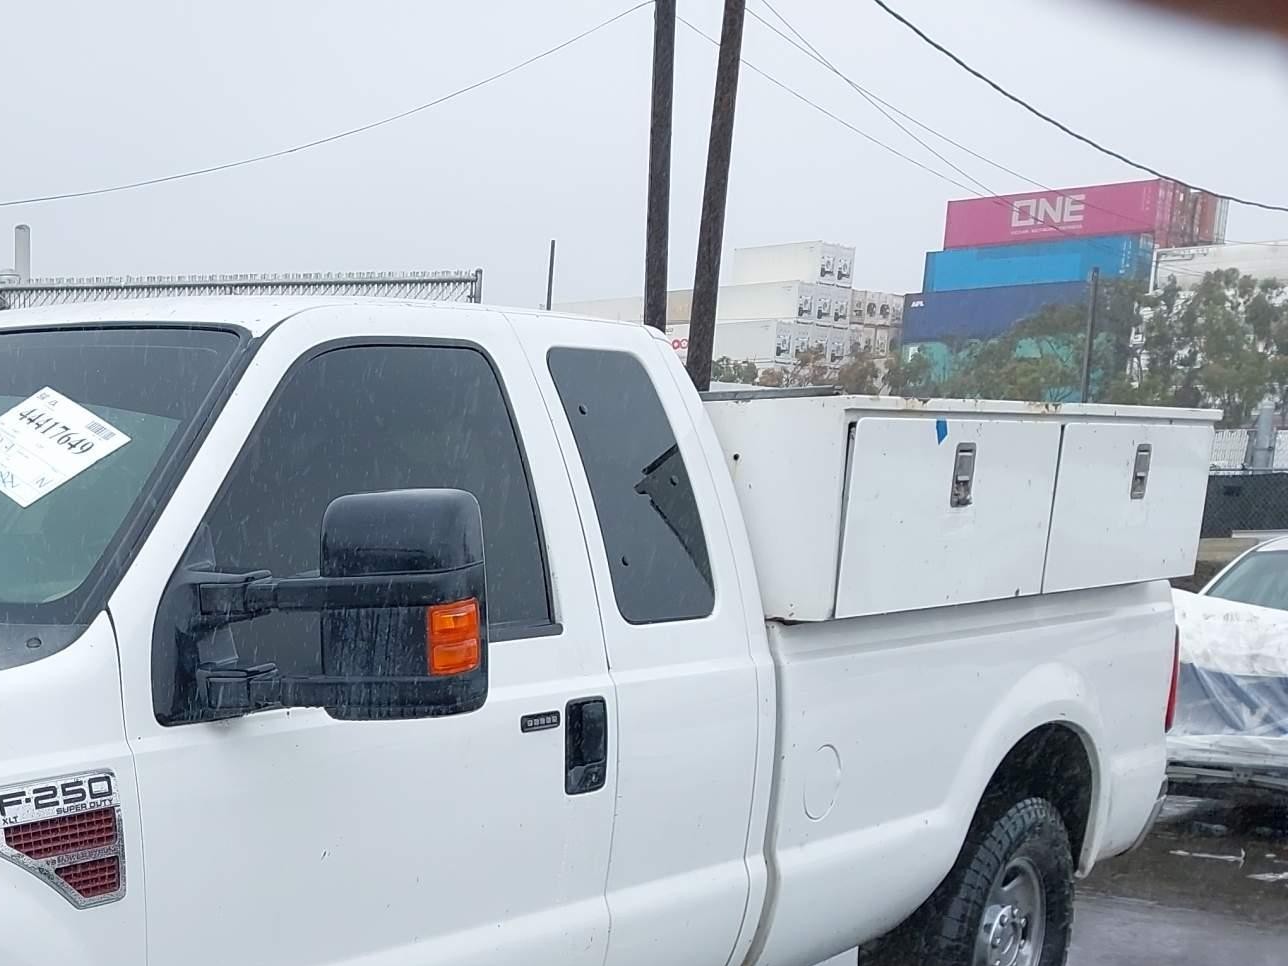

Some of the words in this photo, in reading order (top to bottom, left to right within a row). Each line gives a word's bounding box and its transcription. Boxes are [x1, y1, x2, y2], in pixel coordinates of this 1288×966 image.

[1011, 194, 1085, 227] ONE
[18, 408, 95, 454] 44417649
[2, 815, 19, 826] XLT
[55, 803, 87, 815] SUPER
[89, 798, 114, 809] DUTY
